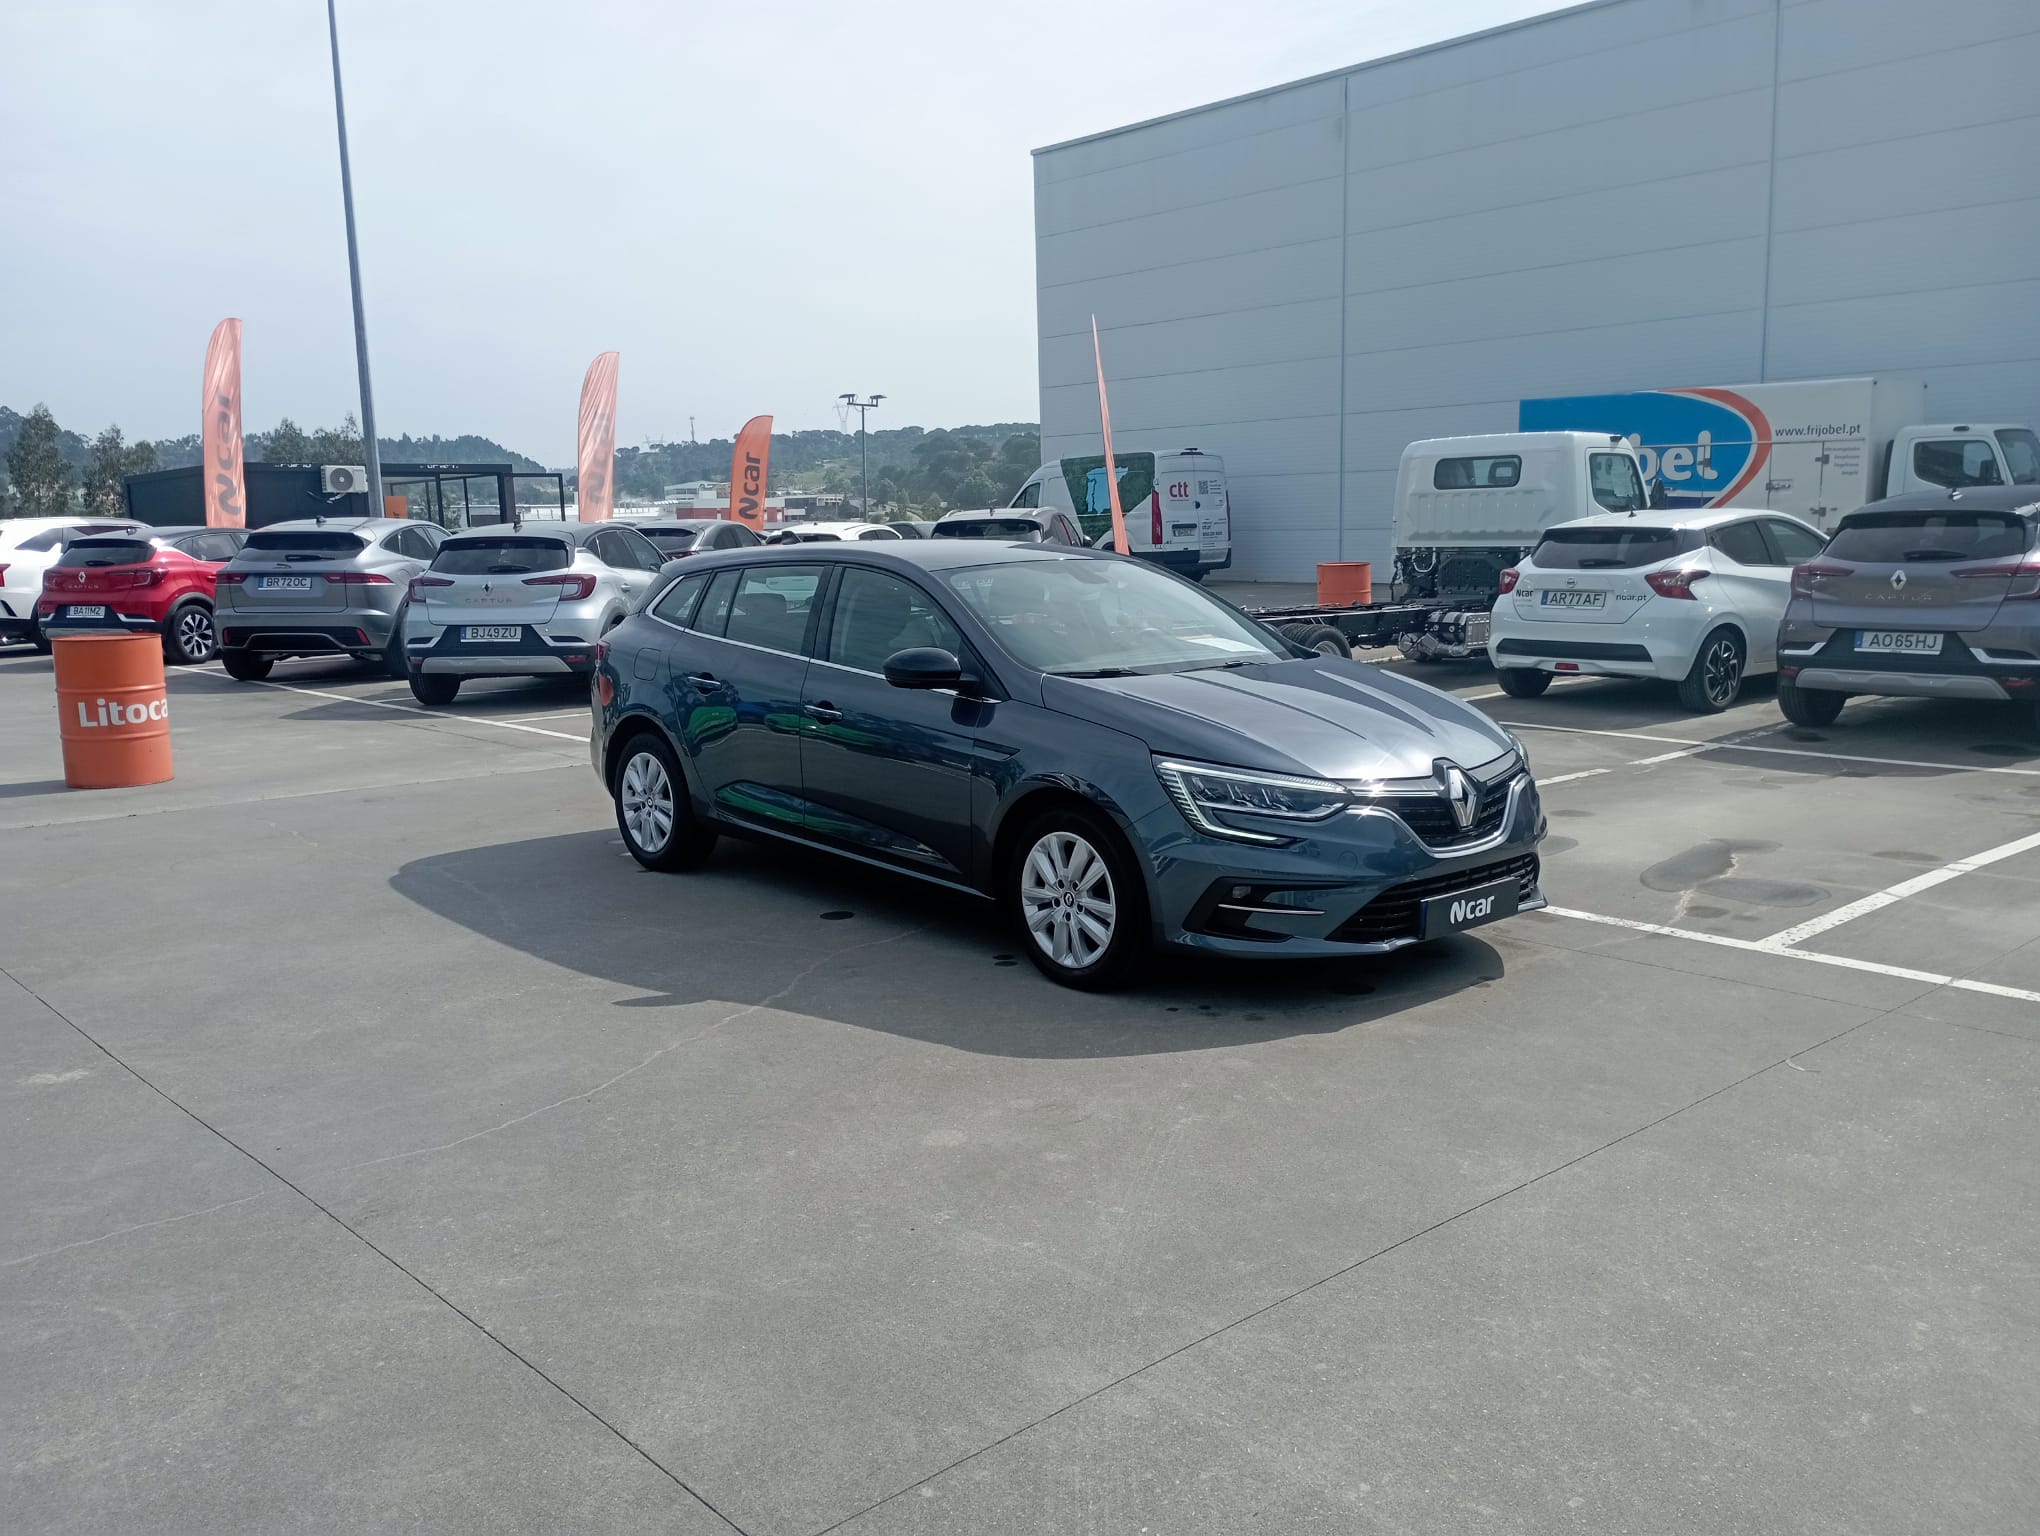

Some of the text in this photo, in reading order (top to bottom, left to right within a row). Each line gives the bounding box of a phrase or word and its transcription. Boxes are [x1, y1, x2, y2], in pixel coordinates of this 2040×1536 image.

[1774, 423, 1862, 437] www.frijobel.pt
[738, 451, 761, 520] Ncar
[1169, 482, 1189, 498] ctt
[1515, 588, 1534, 598] Ncar
[1549, 592, 1603, 606] AR77AF
[1864, 593, 1933, 601] CAPTUR
[471, 628, 517, 638] BJ49ZU
[1868, 633, 1938, 649] AO65HJ
[1449, 895, 1495, 925] Ncar
